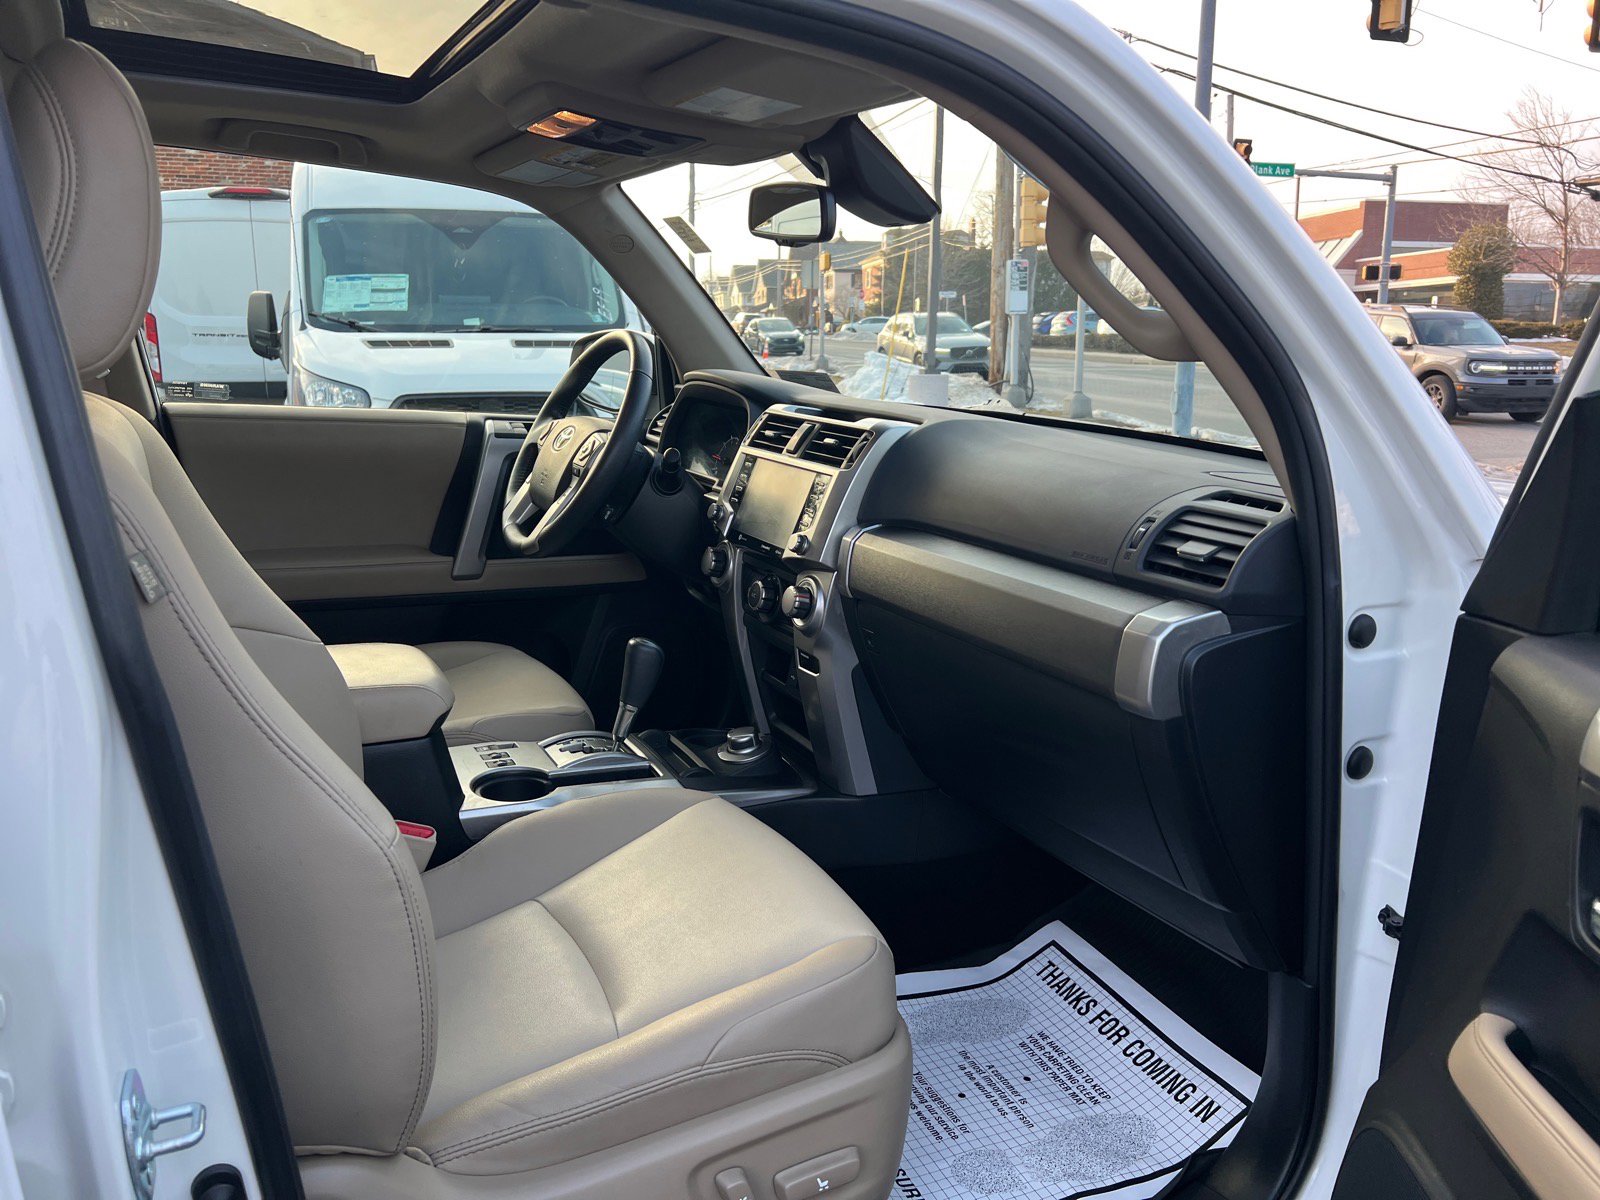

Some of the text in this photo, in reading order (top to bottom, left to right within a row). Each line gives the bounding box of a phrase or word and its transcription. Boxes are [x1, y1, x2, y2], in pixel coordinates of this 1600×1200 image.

[1275, 166, 1290, 175] Ave
[1026, 1034, 1101, 1106] YOUR CARPETING CLEAN
[1036, 960, 1221, 1123] THANKS FOR COMING IN
[1037, 1030, 1111, 1100] WE HAVE TRIED TO KEEP
[913, 1071, 971, 1134] Your suggestions for
[958, 1063, 1008, 1119] in the world to us.
[959, 1050, 1035, 1129] the most important person
[991, 1069, 1021, 1098] customer
[1018, 1097, 1028, 1105] is
[1018, 1041, 1087, 1106] WITH THIS PAPER MAT
[916, 1110, 943, 1143] welcome.
[925, 1104, 938, 1116] our
[935, 1115, 959, 1141] service
[895, 1168, 925, 1200] SUR
